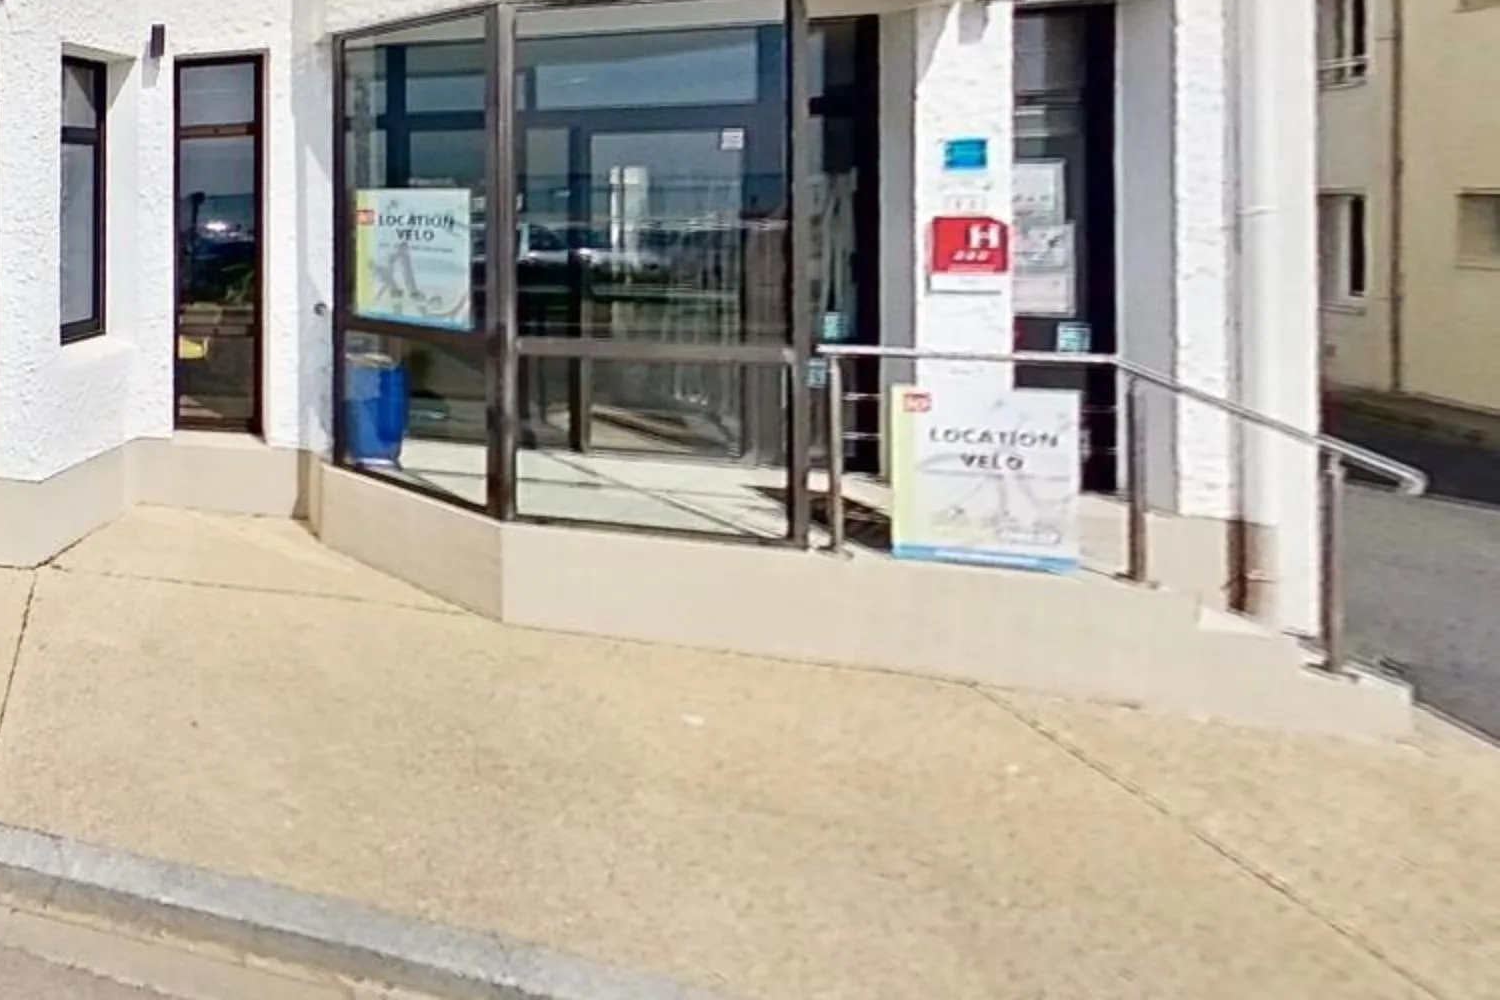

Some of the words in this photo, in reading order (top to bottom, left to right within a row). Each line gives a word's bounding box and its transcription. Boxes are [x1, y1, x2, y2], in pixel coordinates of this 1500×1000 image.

[379, 213, 455, 229] LOCATION
[968, 223, 1001, 249] H
[928, 426, 1059, 448] LOCATION
